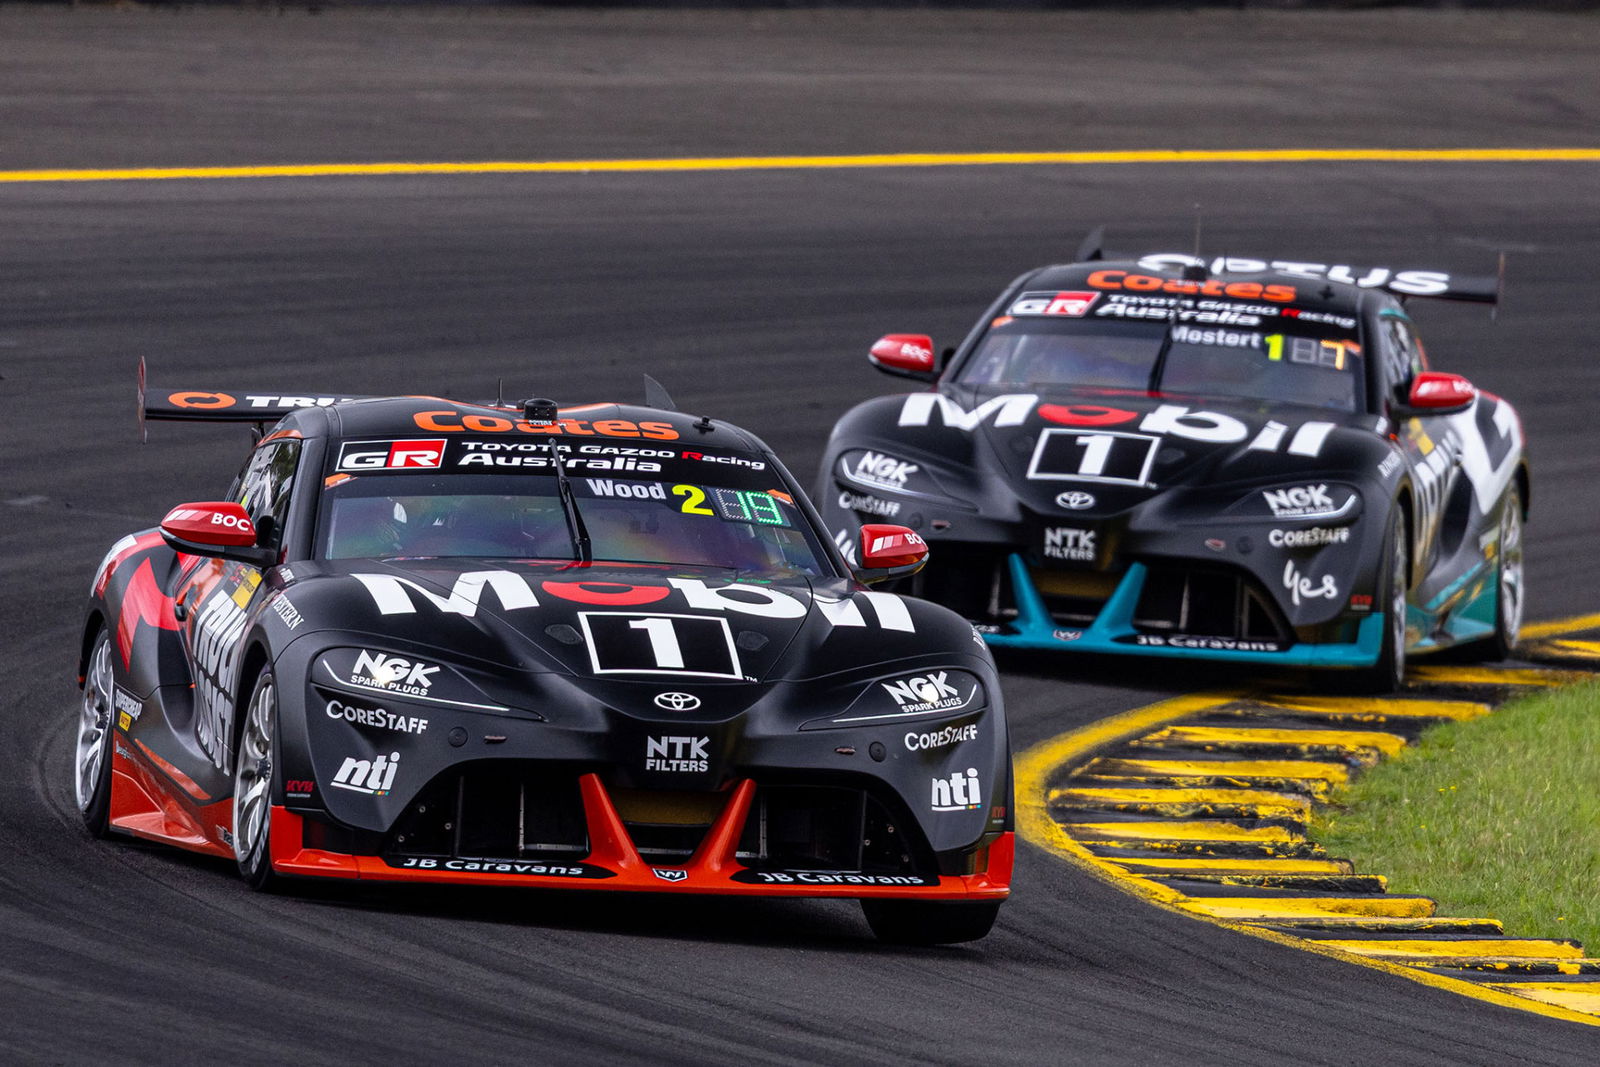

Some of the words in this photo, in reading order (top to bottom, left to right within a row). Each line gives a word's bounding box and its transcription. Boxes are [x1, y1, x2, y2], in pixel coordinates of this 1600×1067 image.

[1087, 270, 1296, 302] Coates
[1012, 299, 1089, 315] GR
[1095, 303, 1260, 326] Australia
[1172, 325, 1260, 348] Mostert
[1264, 334, 1284, 361] 1
[413, 411, 679, 440] Coates
[898, 392, 1335, 458] Mobil
[340, 450, 440, 468] GR
[458, 453, 661, 472] Australia
[461, 442, 572, 453] TOYOTA
[579, 445, 675, 458] GAZOO
[681, 451, 765, 470] Racing
[857, 450, 919, 482] NGK
[1075, 435, 1114, 477] 1
[586, 479, 666, 499] Wood
[671, 484, 714, 516] 2
[1262, 484, 1333, 509] NGK
[211, 513, 250, 532] BOC
[1045, 528, 1096, 549] NTK
[1044, 548, 1094, 561] FILTERS
[350, 570, 915, 632] Mobil
[628, 617, 685, 668] 1
[1168, 637, 1278, 652] Caravans
[352, 649, 440, 687] NGK
[350, 675, 388, 689] SPARK
[388, 681, 429, 696] PLUGS
[881, 671, 959, 705] NGK
[902, 702, 934, 713] SPARK
[934, 697, 962, 709] PLUGS
[647, 735, 710, 760] NTK
[333, 751, 400, 791] nti
[645, 760, 709, 772] FILTERS
[932, 767, 981, 807] nti
[403, 858, 437, 867] JB
[445, 860, 583, 875] Caravans
[758, 872, 794, 882] JB
[797, 873, 924, 884] Caravans
